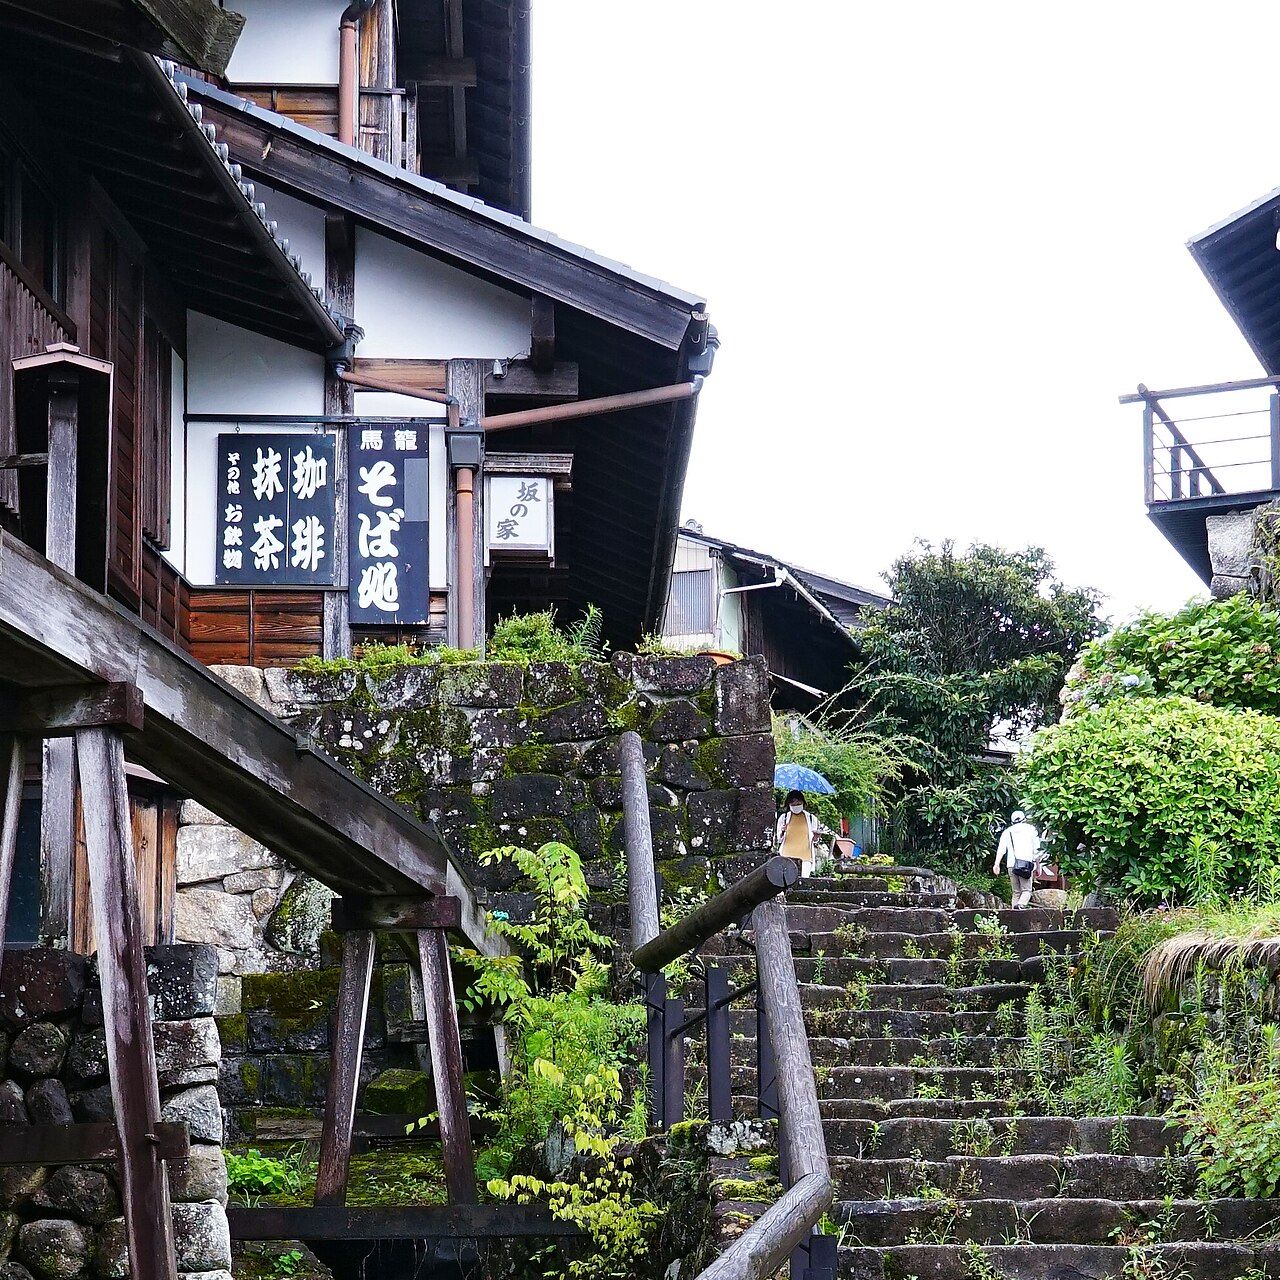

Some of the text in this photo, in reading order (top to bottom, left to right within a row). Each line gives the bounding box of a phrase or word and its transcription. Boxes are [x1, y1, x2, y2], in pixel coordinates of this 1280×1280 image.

[360, 429, 418, 451] 馬籠
[222, 452, 243, 570] その他 お飲物
[249, 446, 285, 572] 抹茶
[290, 445, 329, 572] 珈琲
[357, 460, 405, 612] そば処
[496, 481, 542, 540] 坂の家
